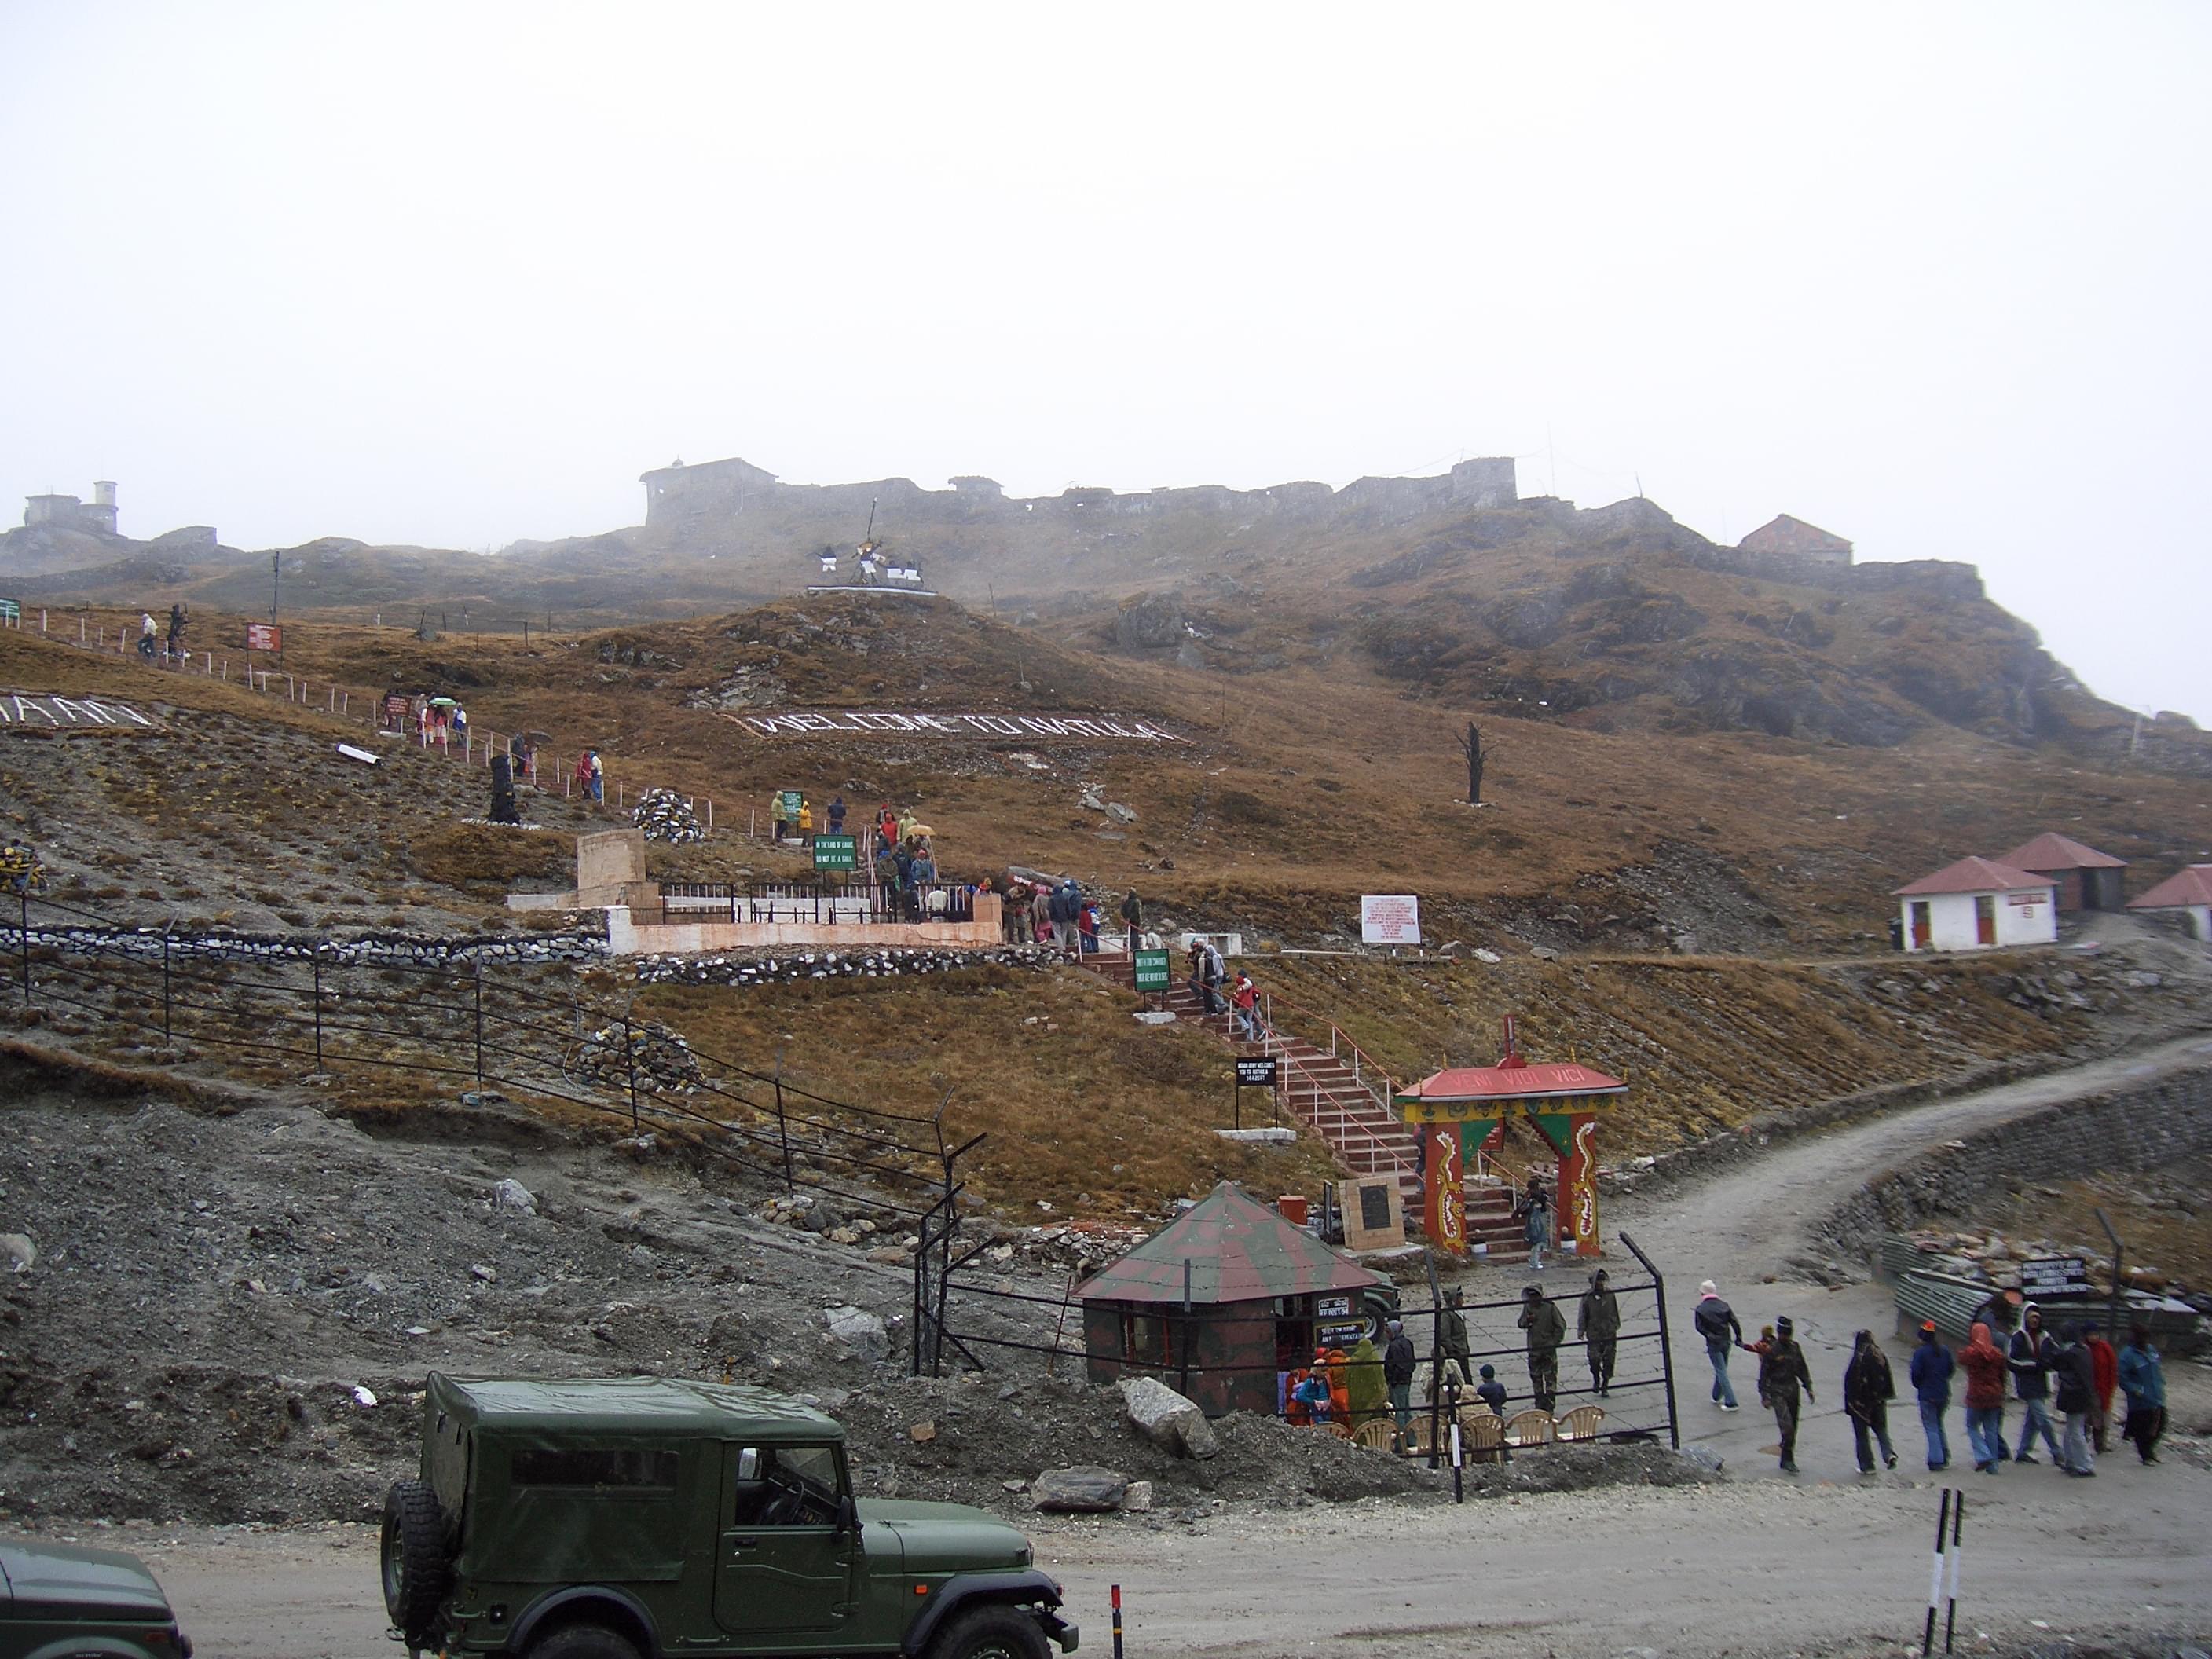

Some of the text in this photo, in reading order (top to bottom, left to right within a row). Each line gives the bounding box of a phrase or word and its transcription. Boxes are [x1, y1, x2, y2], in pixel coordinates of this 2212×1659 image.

[747, 713, 962, 733] WELCOME
[954, 714, 1023, 734] TO
[1449, 1068, 1585, 1088] VENI VIDI VICI
